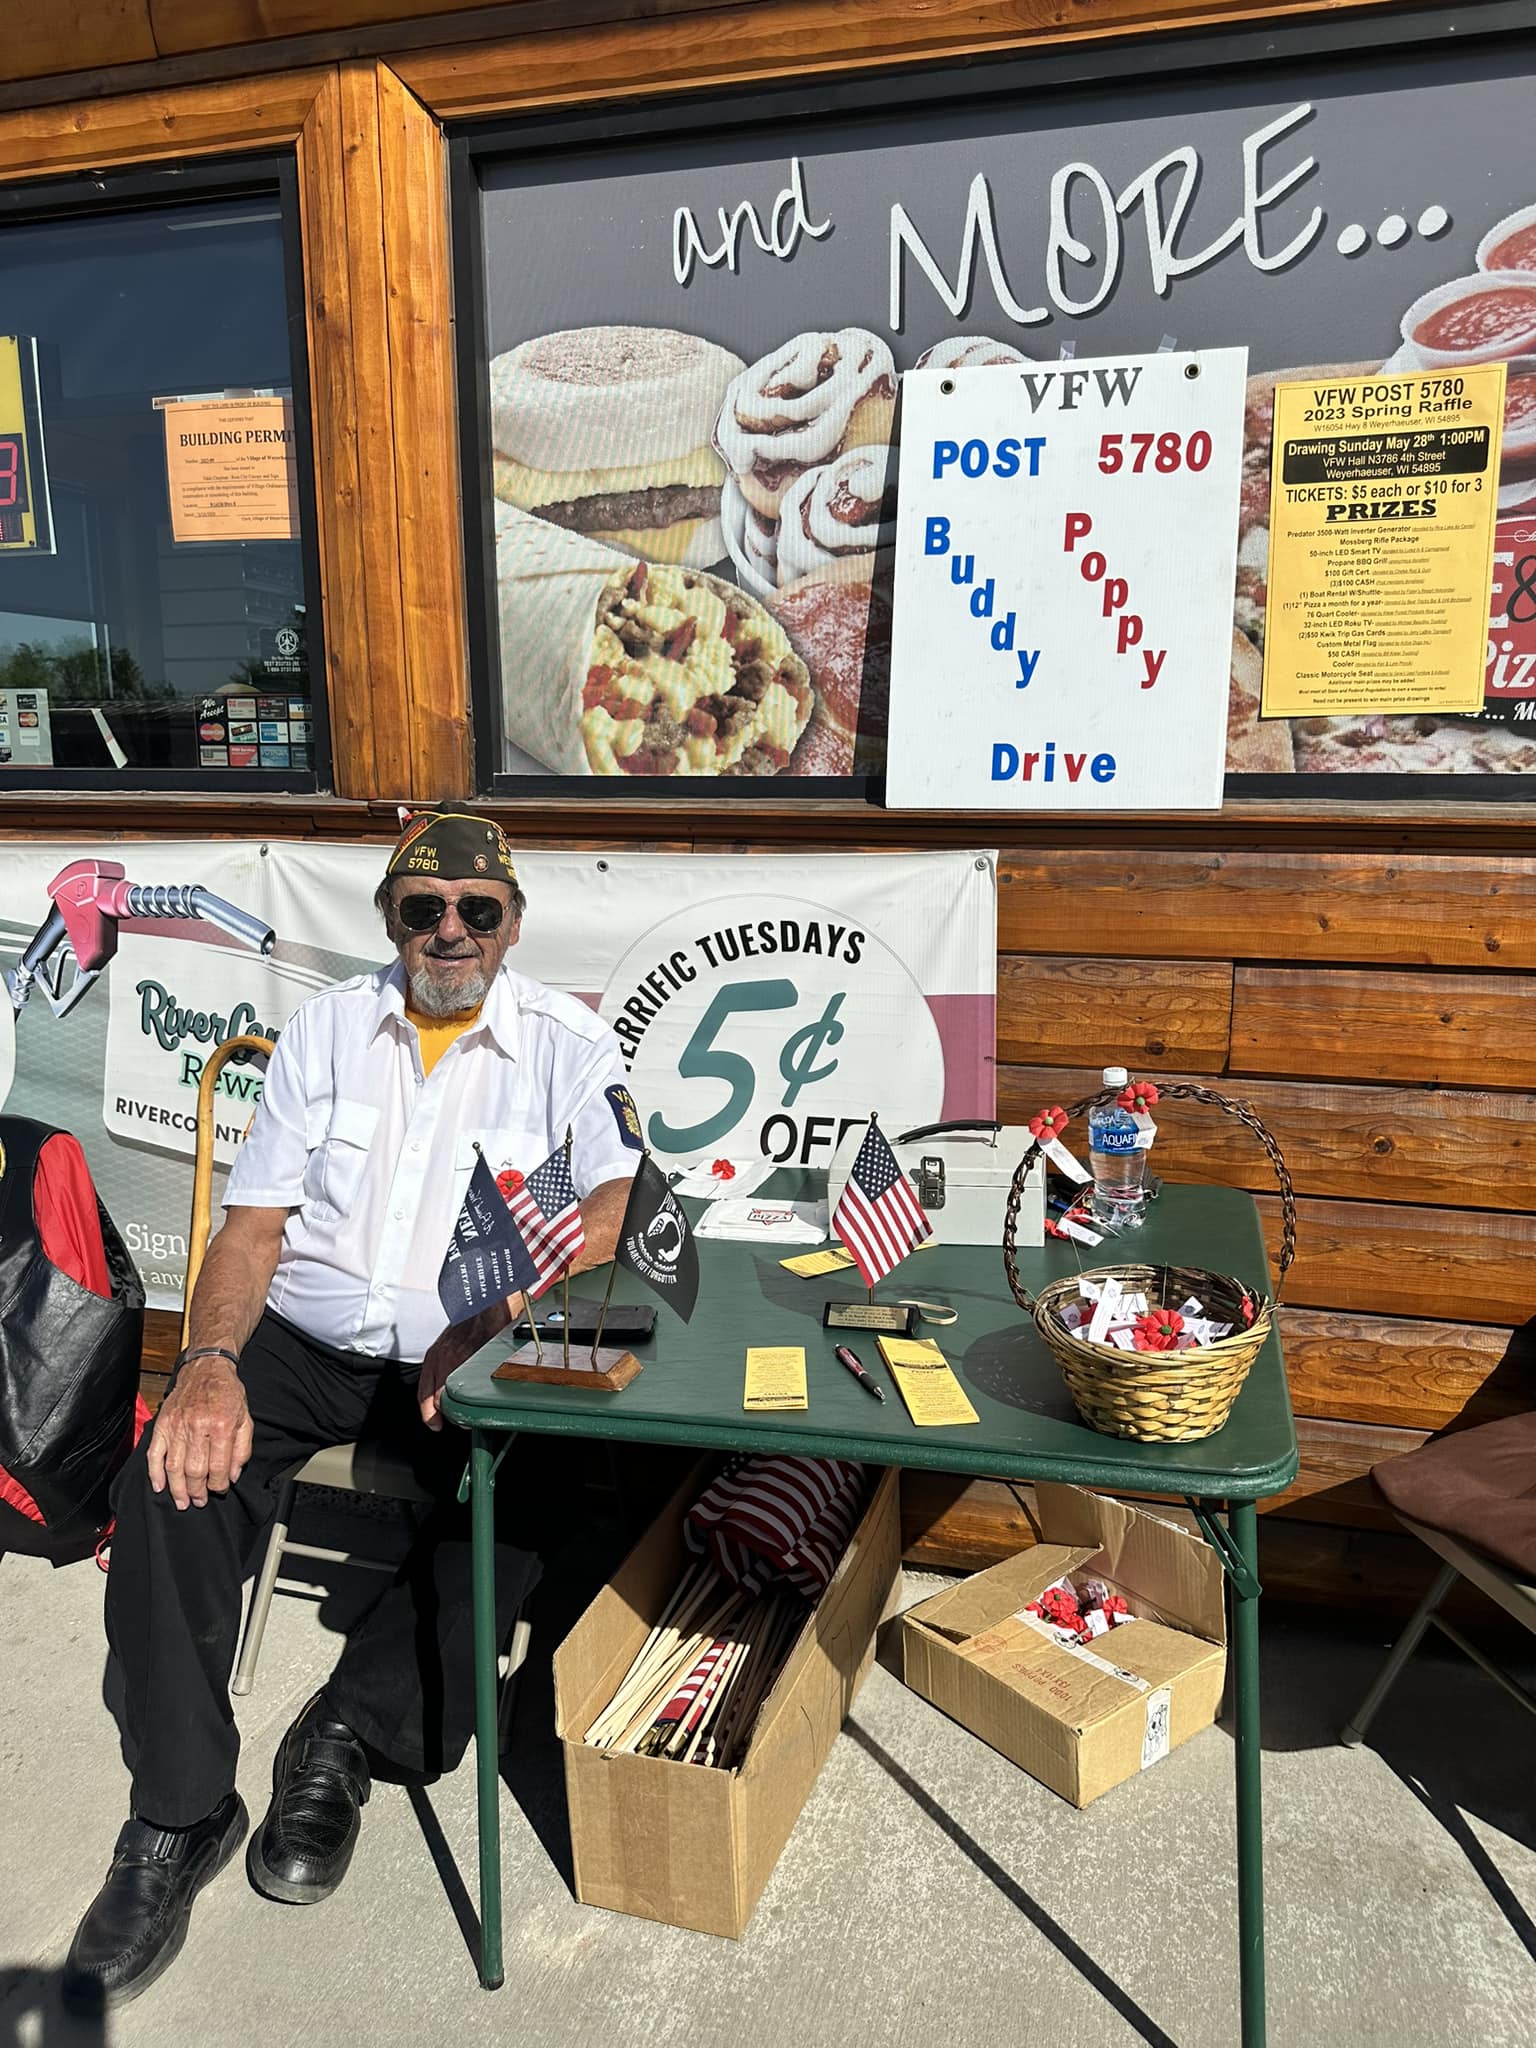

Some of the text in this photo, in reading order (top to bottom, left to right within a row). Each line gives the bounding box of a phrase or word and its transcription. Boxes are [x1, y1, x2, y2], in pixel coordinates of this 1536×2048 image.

[672, 157, 830, 285] and
[1020, 366, 1143, 414] VFW
[1314, 377, 1464, 407] VFW POST 5780
[1304, 398, 1473, 422] 2023 Spring Raffle
[1345, 422, 1361, 431] Hwy
[1362, 421, 1368, 429] 8
[1425, 416, 1436, 424] WI
[180, 430, 295, 447] BUILDING PERMI
[1288, 430, 1485, 456] Drawing Sunday May 28th 1:00PM
[932, 429, 1213, 480] POST 5780
[1322, 450, 1447, 468] VFW Hall N3786 4th Street
[1326, 462, 1441, 480] Weyerhaeuser, WI 54895
[1285, 477, 1482, 503] TICKETS: $5 each or $10 for 3
[1325, 498, 1437, 523] PRIZES
[1287, 530, 1316, 539] Predator
[1350, 527, 1376, 536] Inverter
[1377, 525, 1412, 535] Generator
[1340, 535, 1420, 546] Mossberg Rifle Package
[1309, 550, 1334, 558] 50-inch
[1350, 548, 1371, 556] Smart
[1372, 547, 1382, 555] TV
[1327, 559, 1355, 568] Propane
[1356, 558, 1372, 566] BBQ
[1373, 557, 1389, 565] Grill
[1325, 569, 1341, 577] $100
[1355, 578, 1375, 586] CASH
[1063, 512, 1168, 690] Poppy
[1309, 590, 1326, 598] Boat
[1326, 589, 1348, 597] Rental
[924, 516, 1041, 690] Buddy
[1303, 601, 1321, 609] Pizza
[1327, 600, 1349, 608] month
[1350, 599, 1360, 607] for
[1315, 610, 1335, 618] Quart
[1328, 620, 1343, 628] LED
[1319, 630, 1336, 638] Kwik
[1337, 630, 1351, 638] Trip
[1366, 629, 1386, 637] Cards
[1343, 639, 1361, 648] Metal
[1362, 639, 1377, 647] Flag
[1328, 650, 1340, 658] $50
[1340, 649, 1360, 657] CASH
[1332, 661, 1355, 669] Cooler
[1295, 672, 1320, 680] Classic
[1320, 671, 1357, 680] Motorcycle
[199, 705, 225, 721] Accept
[991, 742, 1118, 784] Drive
[414, 845, 438, 858] VFW
[408, 857, 440, 872] 5780
[613, 919, 866, 1073] ERRIFIC TUESDAYS
[125, 1222, 189, 1261] Sign
[625, 1235, 678, 1285] YOU ARE NOT FORGOTTEN
[150, 1270, 186, 1290] any
